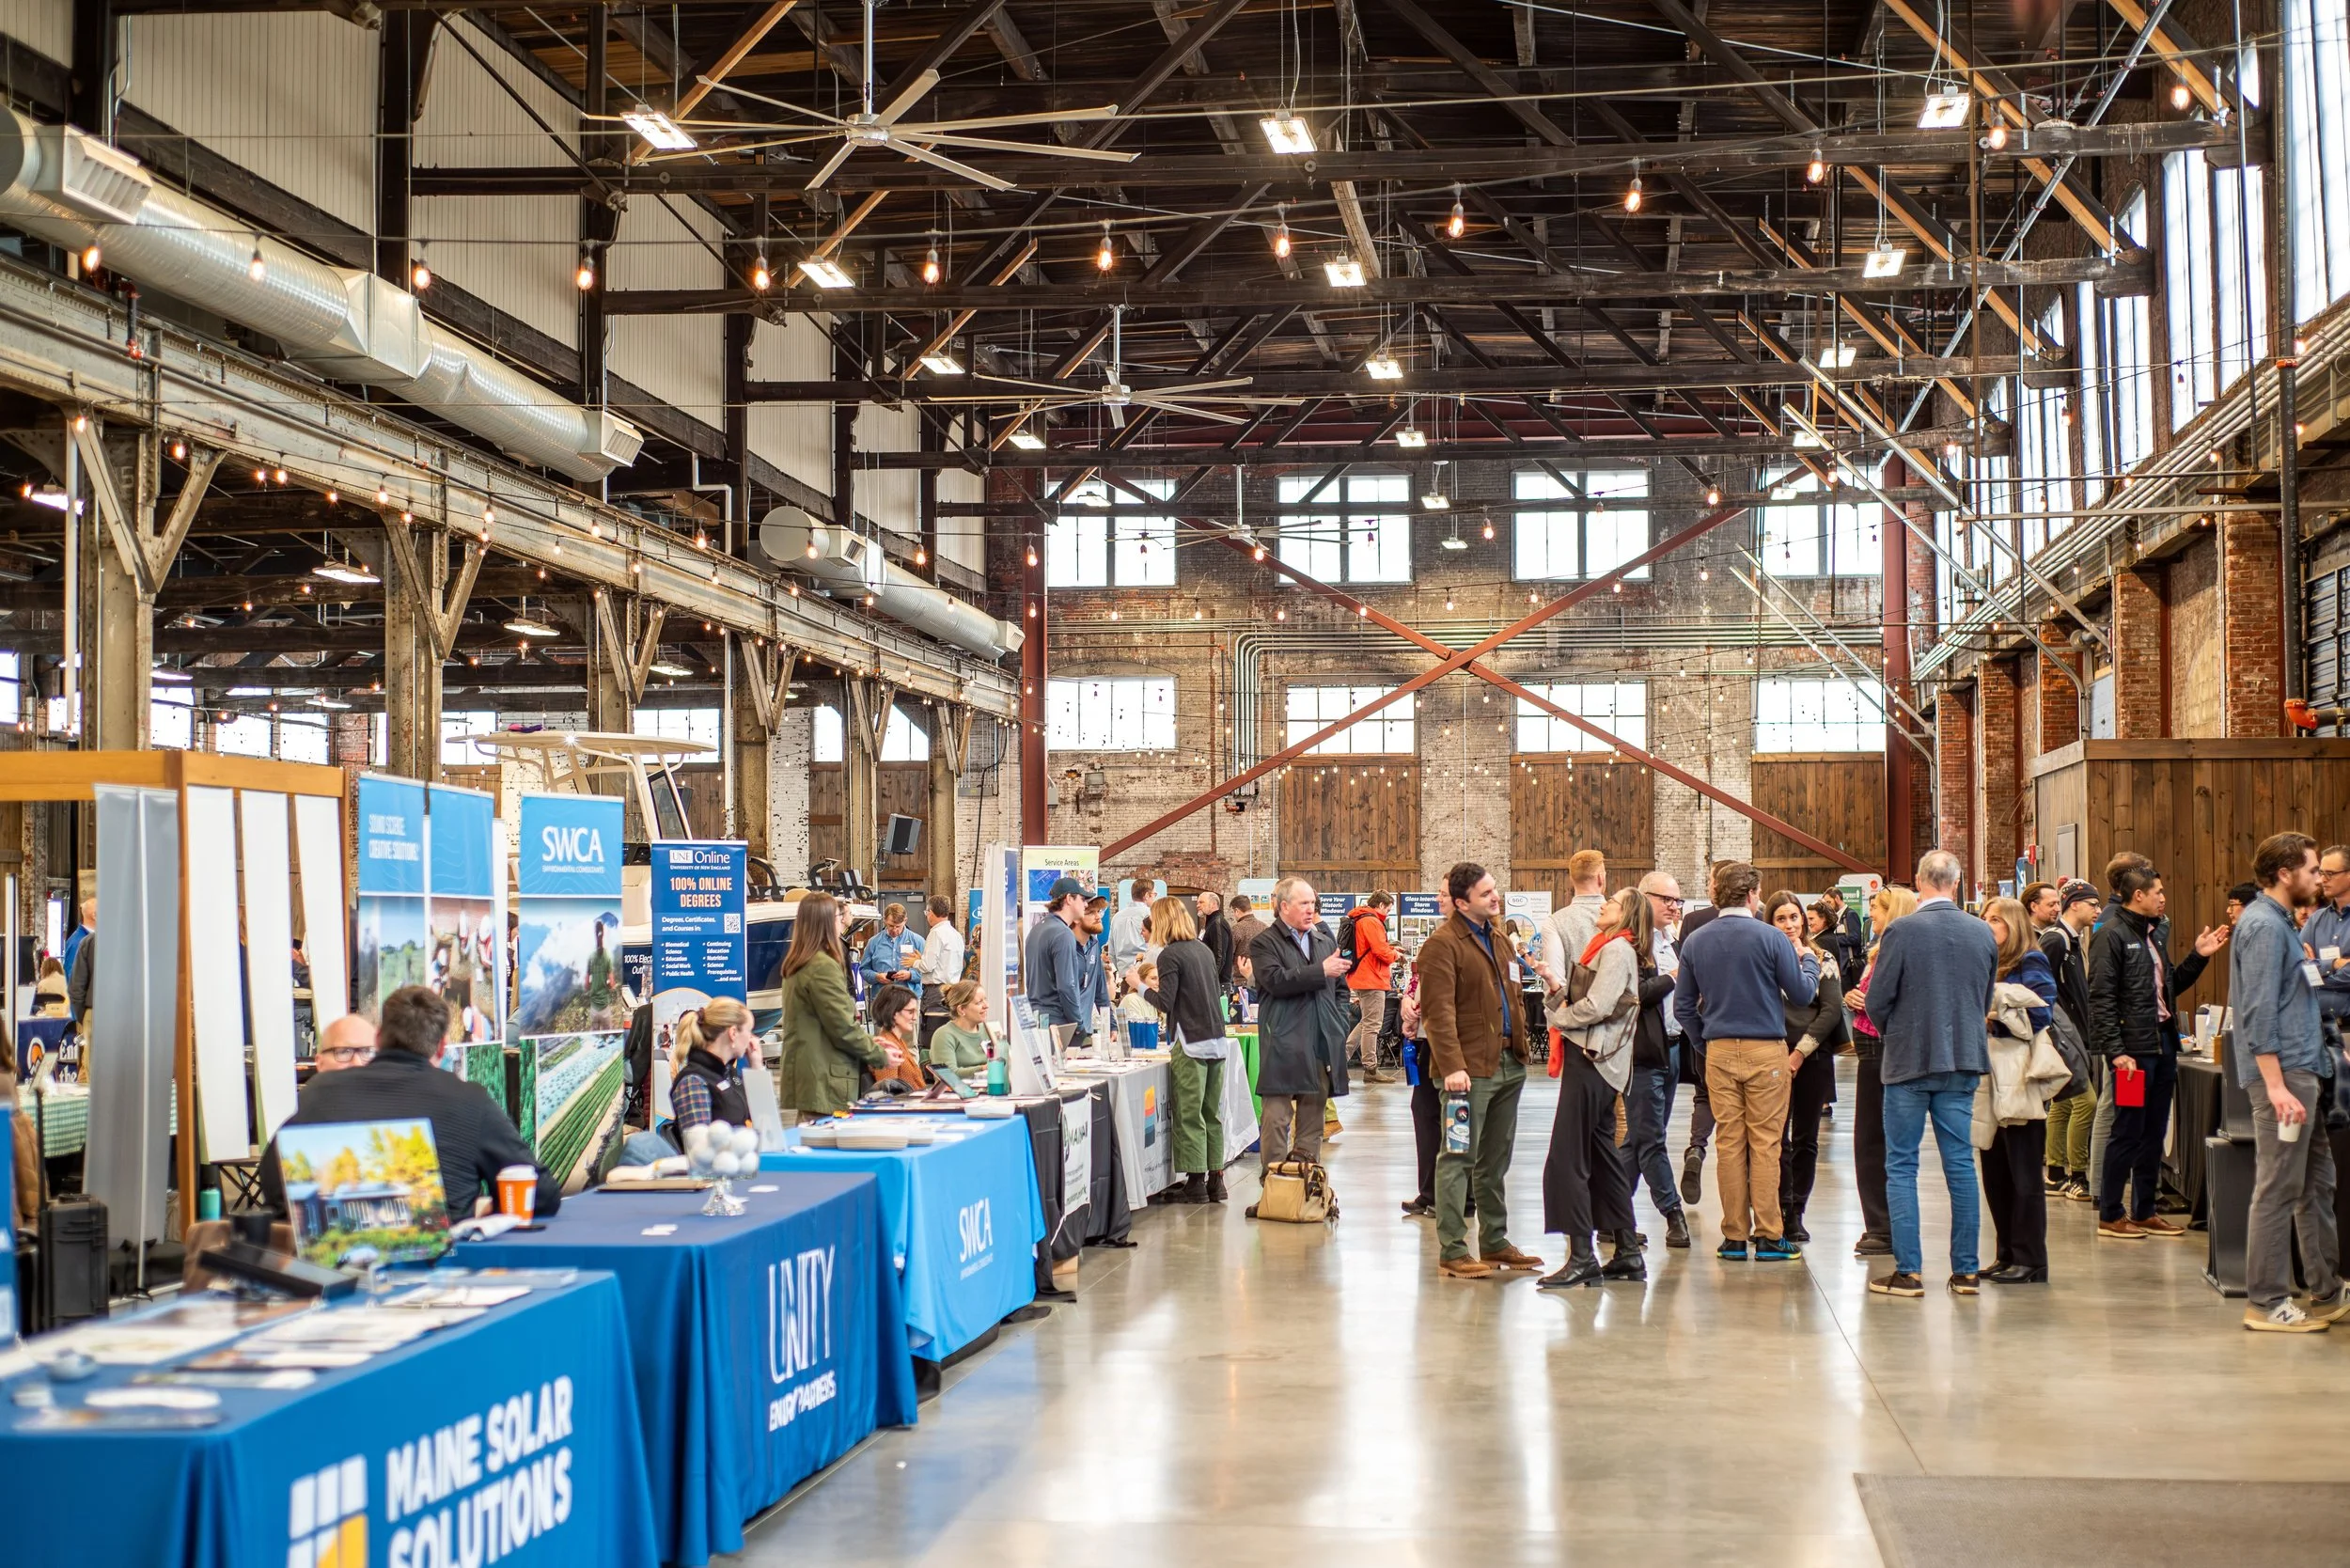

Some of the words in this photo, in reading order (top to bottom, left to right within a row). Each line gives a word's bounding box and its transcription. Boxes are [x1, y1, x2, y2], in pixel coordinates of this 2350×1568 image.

[542, 825, 604, 863] SWCA
[670, 851, 692, 863] UNE
[695, 851, 730, 864] Online
[670, 877, 696, 891] 100%
[698, 877, 732, 891] ONLINE
[680, 894, 722, 908] DEGREES
[624, 954, 638, 964] 100%
[639, 954, 652, 964] Elect
[959, 1197, 993, 1263] SWCA
[769, 1244, 836, 1385] UNITY
[386, 1413, 483, 1524] MAINE
[486, 1374, 573, 1473] SOLAR
[388, 1445, 572, 1568] SOLUTIONS
